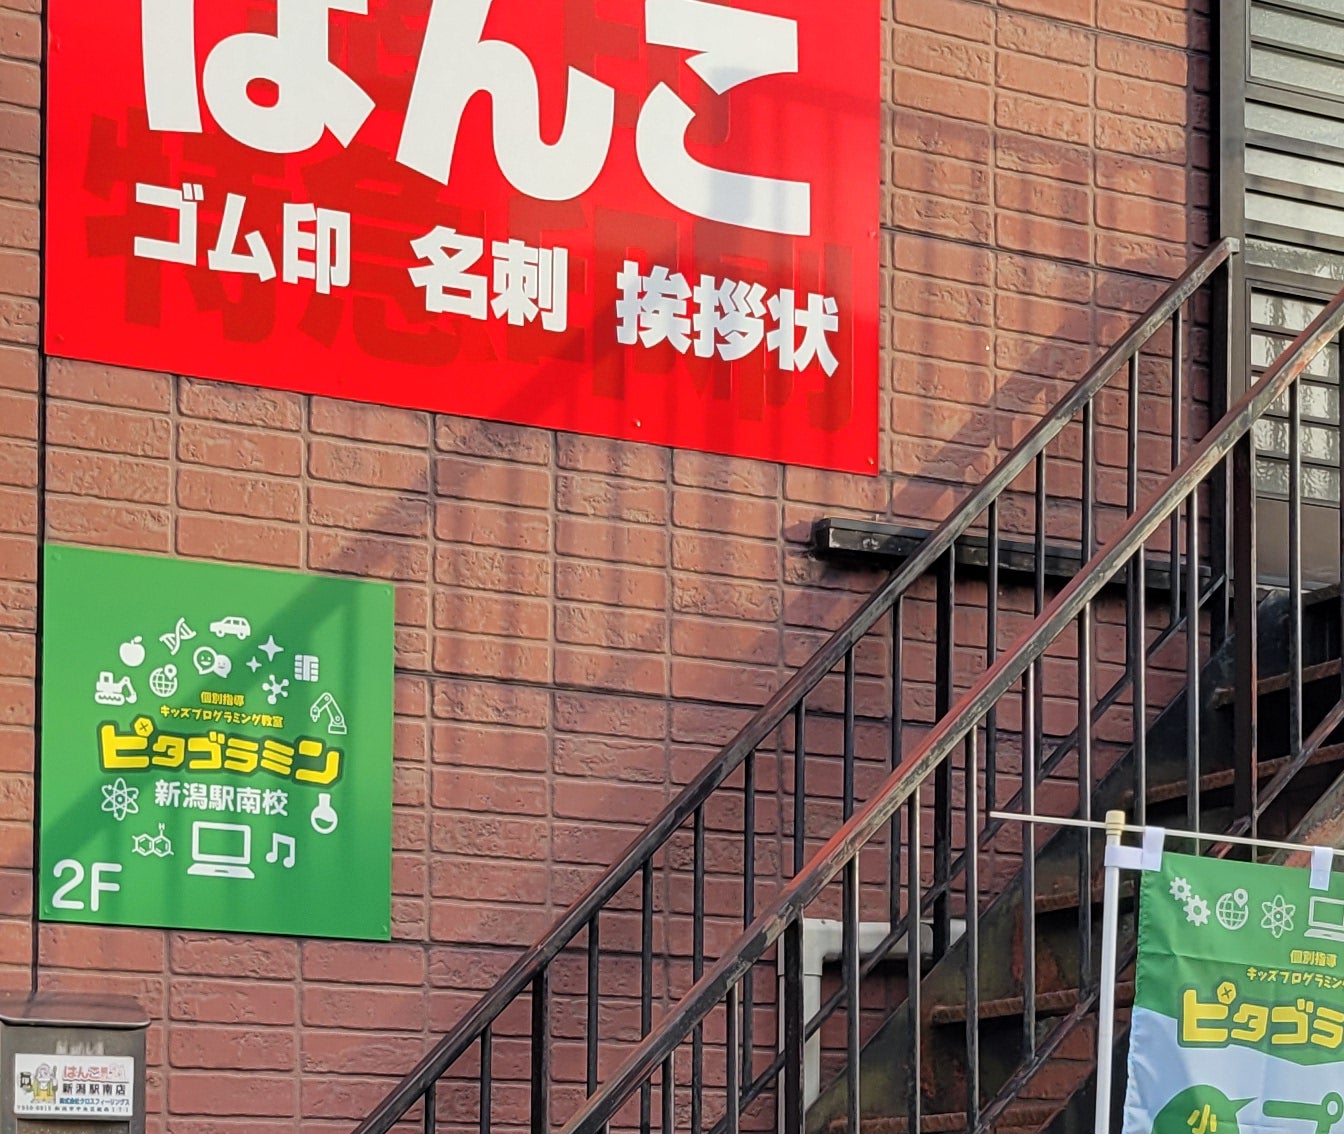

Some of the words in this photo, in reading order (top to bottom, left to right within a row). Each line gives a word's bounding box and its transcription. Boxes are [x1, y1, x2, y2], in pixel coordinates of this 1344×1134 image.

[133, 182, 352, 295] ゴム印
[408, 227, 569, 333] 名刺
[615, 261, 840, 377] 挨拶状
[200, 691, 244, 707] 個別指導
[160, 705, 284, 729] キッズプログラミング教室
[99, 717, 341, 785] ピタゴラミン
[154, 780, 289, 816] 新潟駅南校
[52, 859, 123, 912] 2F
[1290, 949, 1337, 968] 個別指導
[63, 1083, 126, 1096] 新潟駅南店
